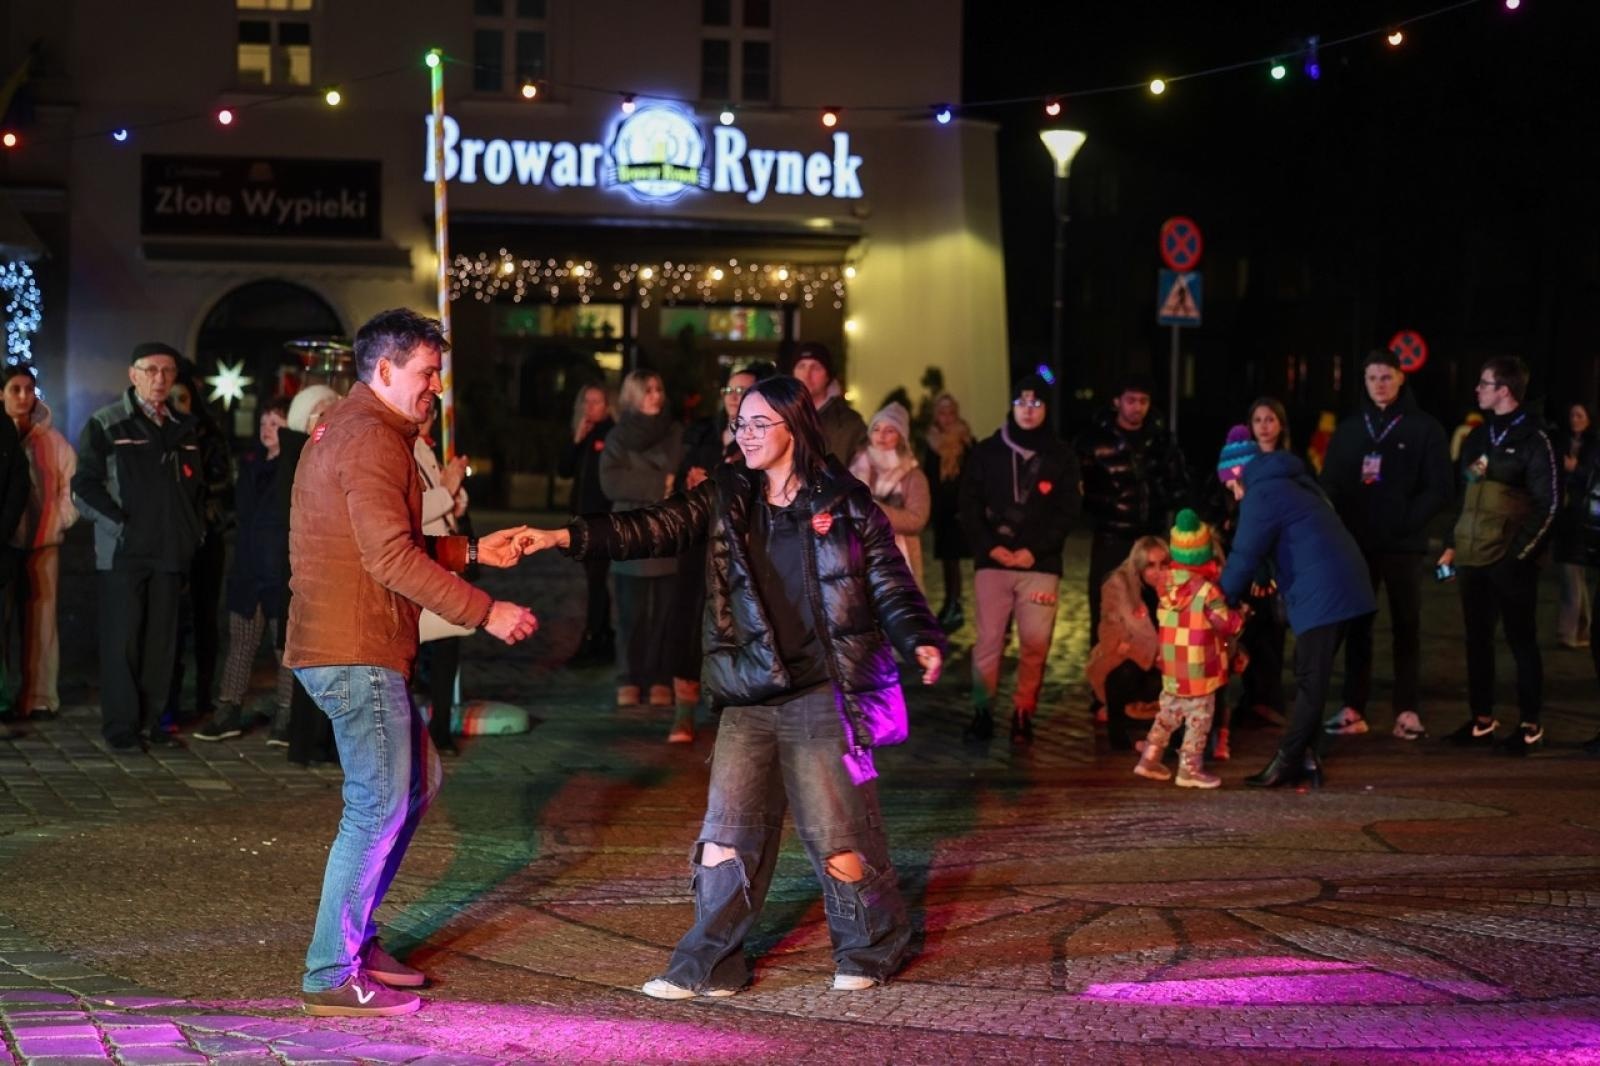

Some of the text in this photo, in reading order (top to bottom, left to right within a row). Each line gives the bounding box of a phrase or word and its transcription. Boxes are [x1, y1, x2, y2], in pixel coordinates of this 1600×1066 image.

[424, 114, 863, 204] Browar Rynek
[156, 186, 367, 225] Złote Wypieki
